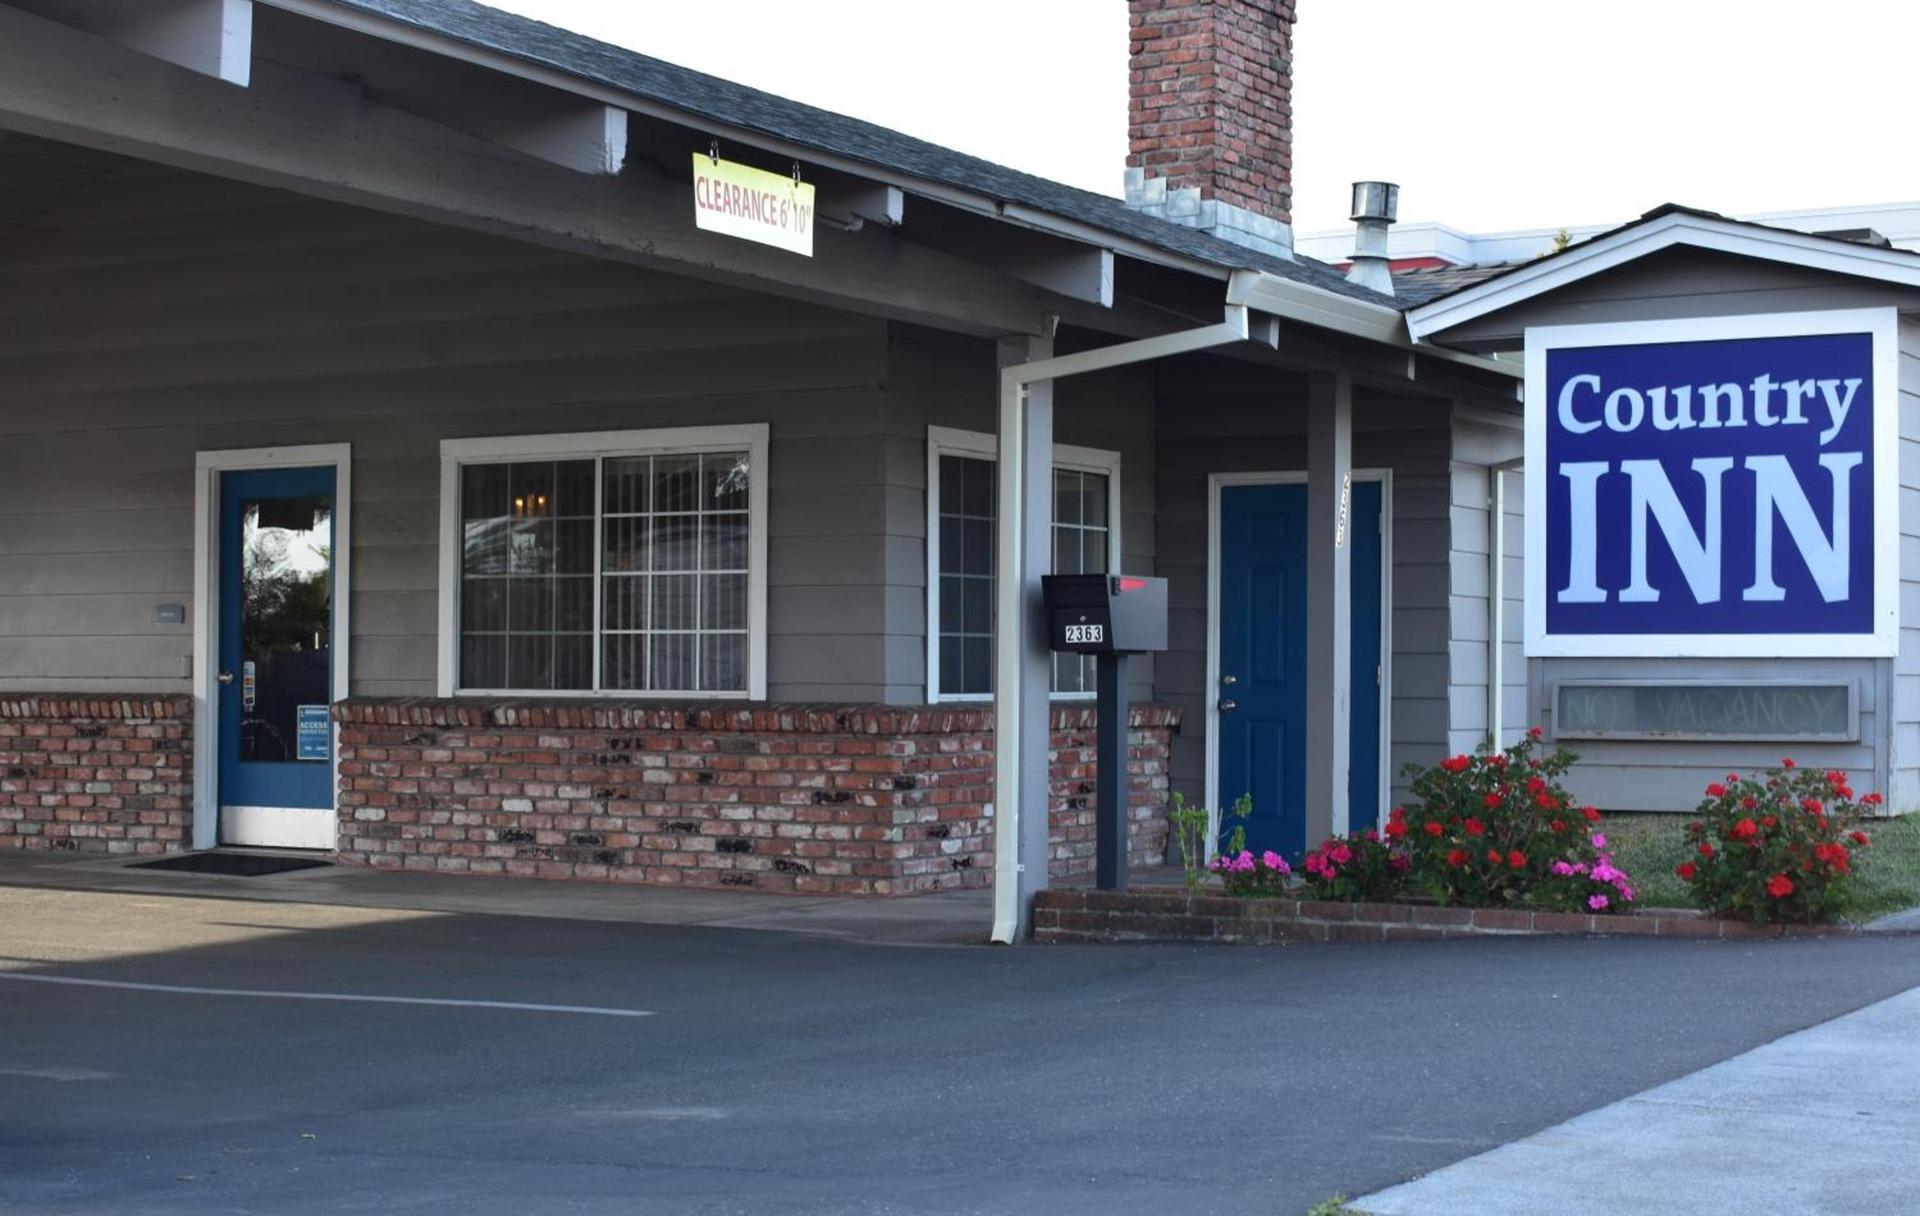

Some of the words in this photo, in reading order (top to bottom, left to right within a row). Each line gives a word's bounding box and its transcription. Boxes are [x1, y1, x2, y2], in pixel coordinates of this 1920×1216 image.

[696, 176, 777, 226] CLEARANCE
[1557, 373, 1863, 446] Country
[1557, 451, 1863, 605] INN
[1066, 626, 1101, 642] 2363
[1567, 689, 1618, 729] NO
[1655, 688, 1842, 731] VACANCY
